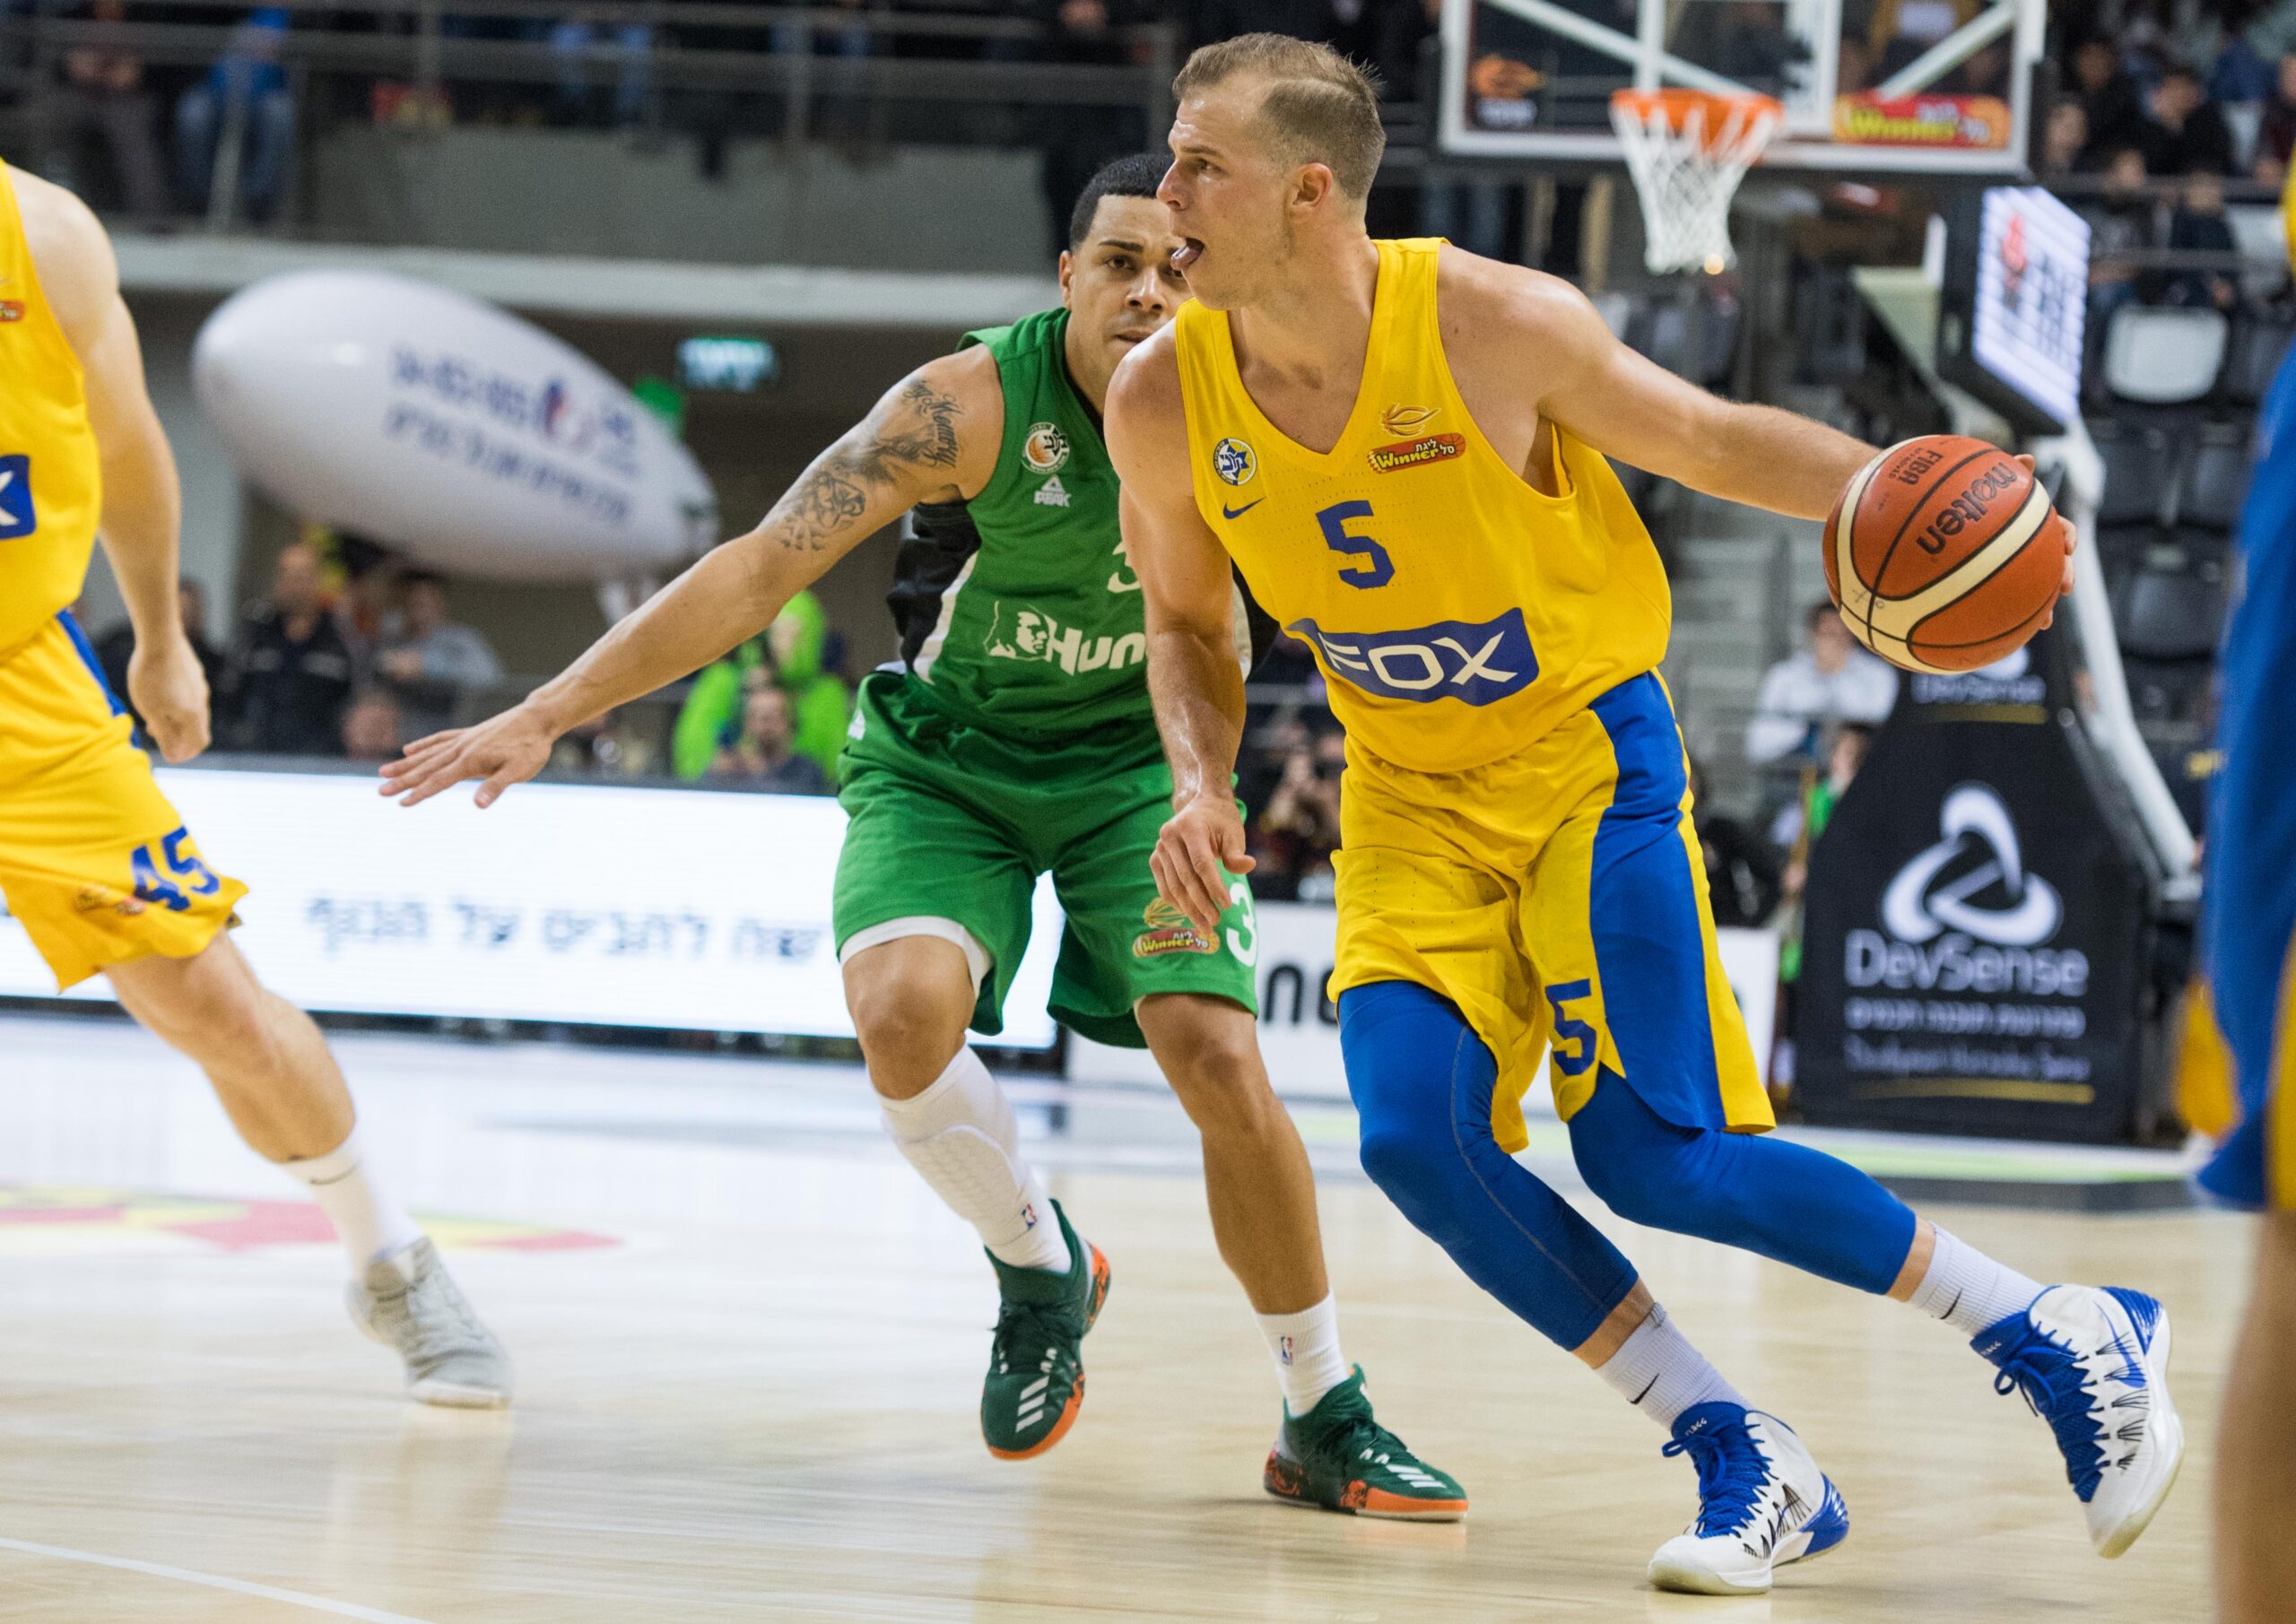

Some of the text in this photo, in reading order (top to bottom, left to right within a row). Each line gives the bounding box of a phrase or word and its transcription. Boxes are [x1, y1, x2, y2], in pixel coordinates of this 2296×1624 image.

[1376, 448, 1439, 469] Winner
[1898, 449, 1944, 484] FIBA
[1916, 461, 2017, 554] molten
[1316, 499, 1396, 589] 5
[1046, 613, 1147, 676] Hun
[1318, 630, 1518, 690] FOX
[131, 825, 221, 912] 45
[1143, 938, 1195, 952] Winner
[1226, 882, 1257, 968] 3
[1844, 927, 2090, 997] DevSense
[1545, 977, 1596, 1076] 5
